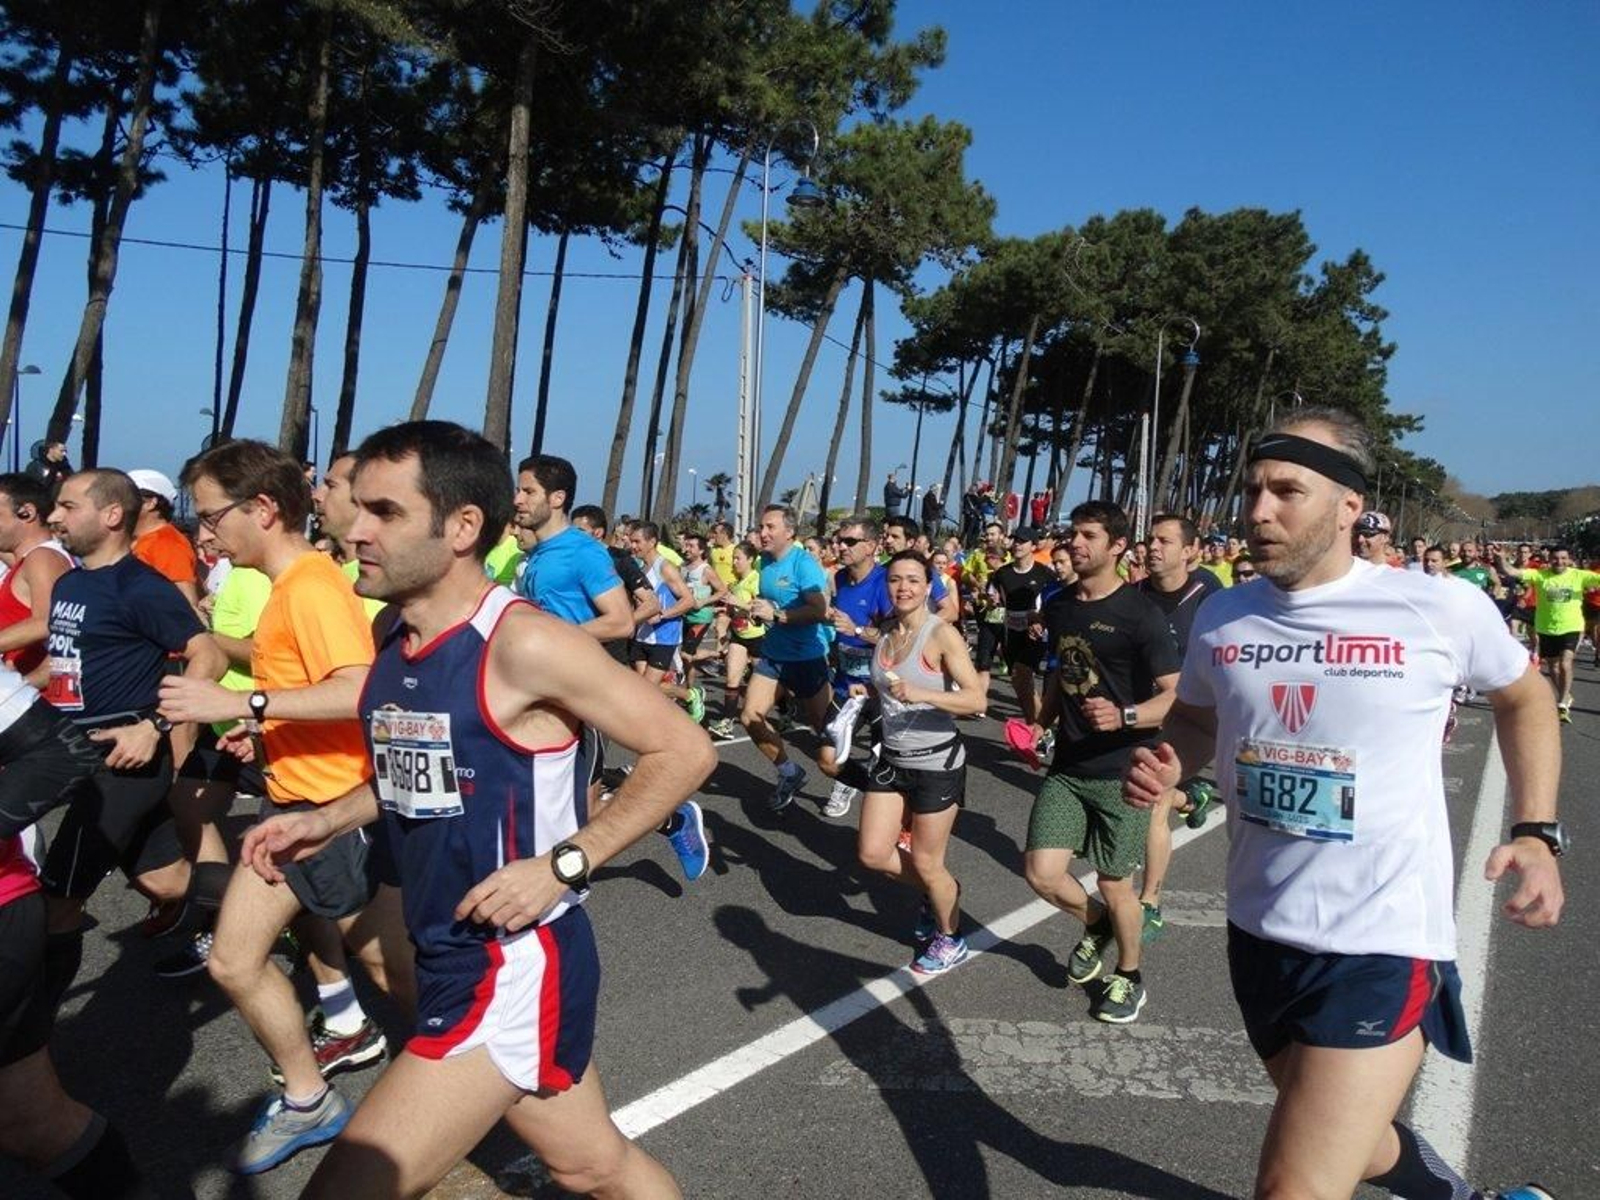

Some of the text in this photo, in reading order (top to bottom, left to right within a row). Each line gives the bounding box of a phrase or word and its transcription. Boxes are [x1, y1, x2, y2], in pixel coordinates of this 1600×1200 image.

[53, 601, 86, 621] MAIA
[1324, 667, 1404, 679] club deportivo
[387, 720, 426, 736] VIG-BAY
[1263, 746, 1327, 766] VIG-BAY
[1260, 772, 1318, 815] 682
